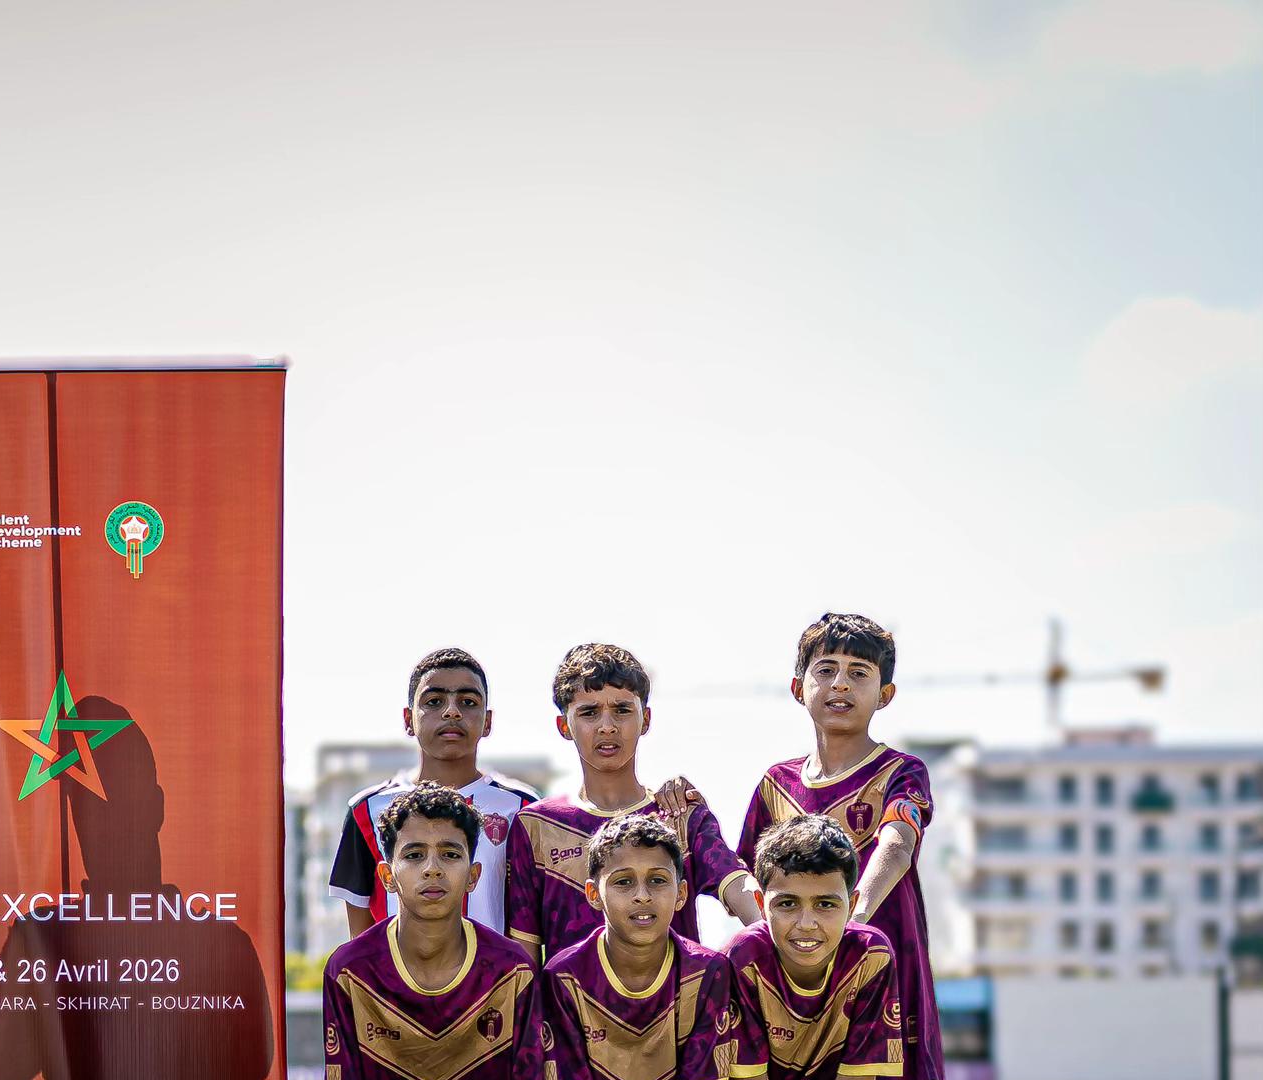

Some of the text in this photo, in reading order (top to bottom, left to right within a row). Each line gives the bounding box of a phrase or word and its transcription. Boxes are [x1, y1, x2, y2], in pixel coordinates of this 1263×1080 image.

[17, 959, 47, 983] 26
[55, 959, 108, 983] Avril
[119, 959, 180, 983] 2026
[56, 996, 131, 1010] SKHIRAT
[151, 995, 245, 1010] BOUZNIKA
